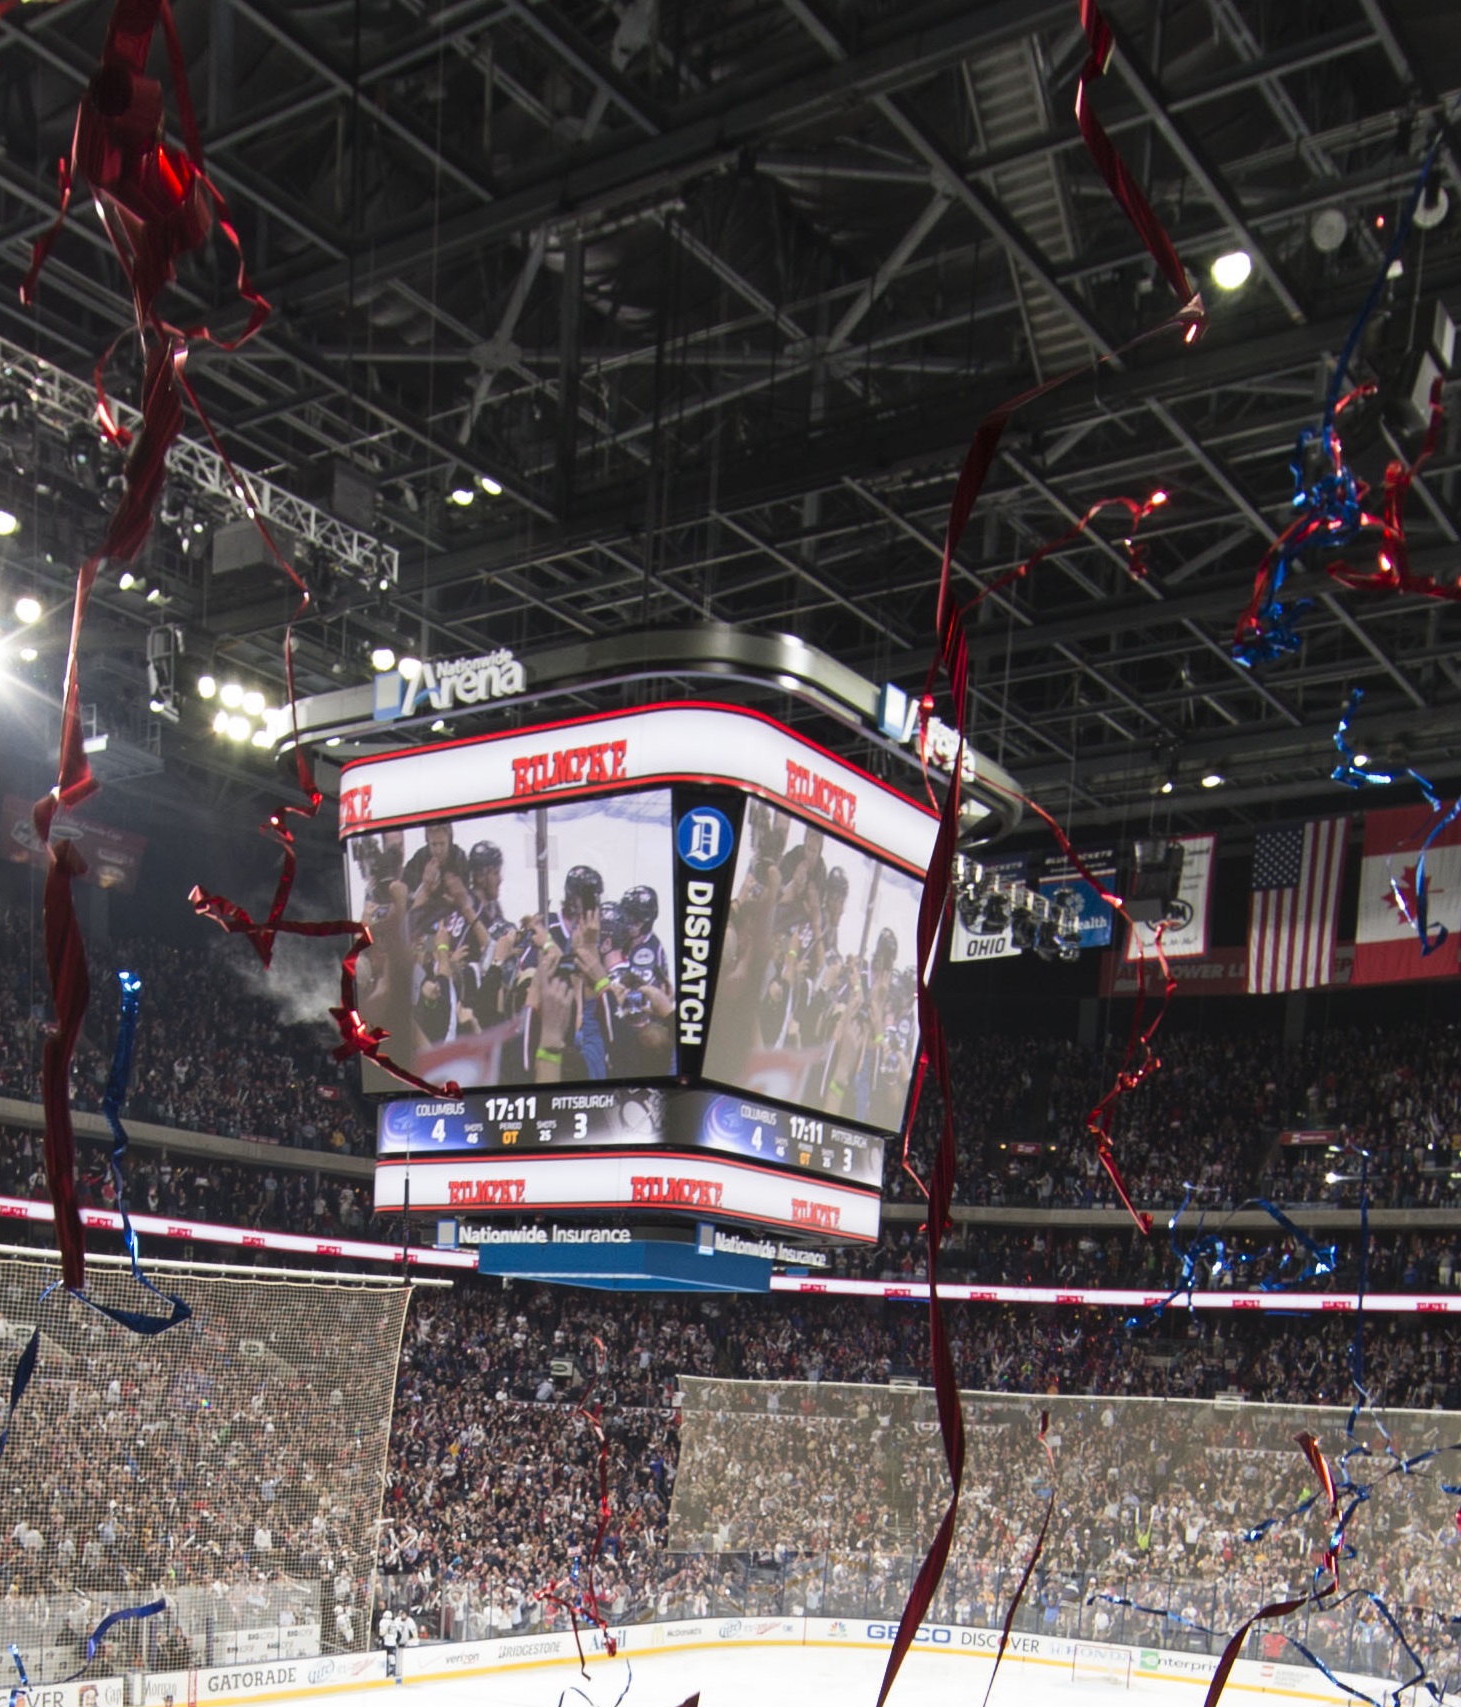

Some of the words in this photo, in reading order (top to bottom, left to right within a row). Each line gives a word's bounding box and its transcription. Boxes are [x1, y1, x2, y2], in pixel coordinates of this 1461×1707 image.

[435, 648, 514, 679] Nationwide
[401, 661, 527, 717] Arena
[512, 739, 617, 797] RUMPKE
[786, 759, 857, 834] RUMPKE
[966, 938, 1006, 957] OHIO
[679, 881, 715, 1045] DISPATCH
[416, 1102, 465, 1117] COLUMBUS
[485, 1097, 537, 1122] 17:11
[552, 1095, 614, 1111] PITTSBURGH
[431, 1119, 446, 1142] 4
[573, 1113, 588, 1140] 3
[502, 1131, 519, 1145] OT
[741, 1104, 777, 1126] COLUMBUS
[790, 1116, 823, 1145] 17:11
[831, 1128, 868, 1149] PITTSBURGH
[751, 1126, 762, 1151] 4
[842, 1148, 853, 1172] 3
[448, 1179, 525, 1204] RUMPKE
[631, 1176, 723, 1208] RUMPKE
[791, 1197, 841, 1229] RUMPKE
[459, 1225, 548, 1244] Nationwide
[552, 1224, 632, 1243] Insurance
[715, 1231, 776, 1259] Nationwide
[777, 1241, 827, 1267] Insurance
[590, 1630, 626, 1651] Ail
[867, 1624, 951, 1644] GECO
[445, 1652, 480, 1665] verizon
[498, 1641, 562, 1659] BRIDGESTONE
[1147, 1653, 1219, 1673] enterpris
[208, 1667, 297, 1693] GATORADE
